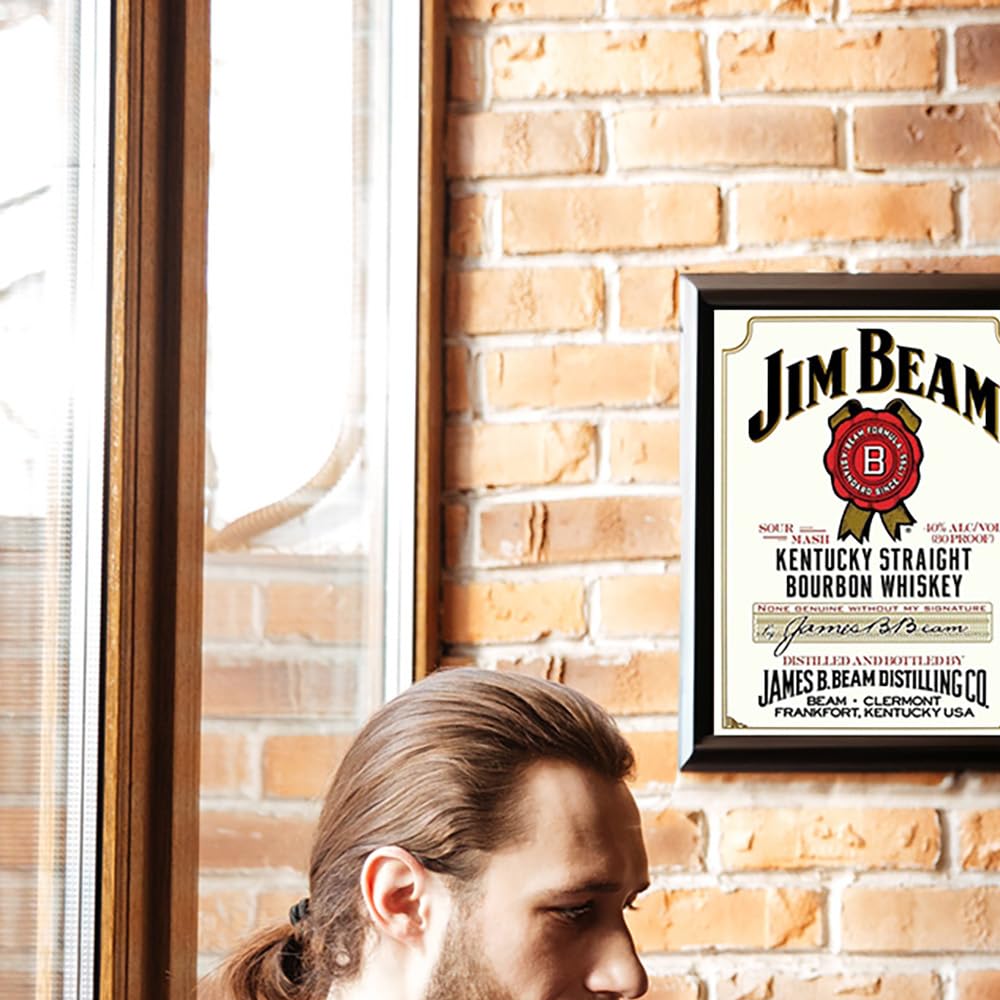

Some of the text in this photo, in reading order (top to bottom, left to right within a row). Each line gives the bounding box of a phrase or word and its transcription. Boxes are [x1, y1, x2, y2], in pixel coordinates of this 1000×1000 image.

[748, 328, 1000, 443] JIM BEAM
[844, 426, 902, 450] BEAM FORMULA
[863, 445, 887, 475] B
[758, 523, 794, 533] SOUR
[791, 534, 830, 545] MASH
[776, 547, 972, 571] KENTUCKY STRAIGHT
[786, 574, 963, 598] BOURBON WHISKEY
[774, 615, 859, 657] James
[783, 655, 965, 666] DISTILLED AND BOTTLED BY
[758, 668, 990, 709] JAMES B. BEAM DISTILLING CO.
[806, 695, 942, 706] BEAM CLERMONT
[774, 707, 975, 719] FRANKFORT, KENTUCKY USA
